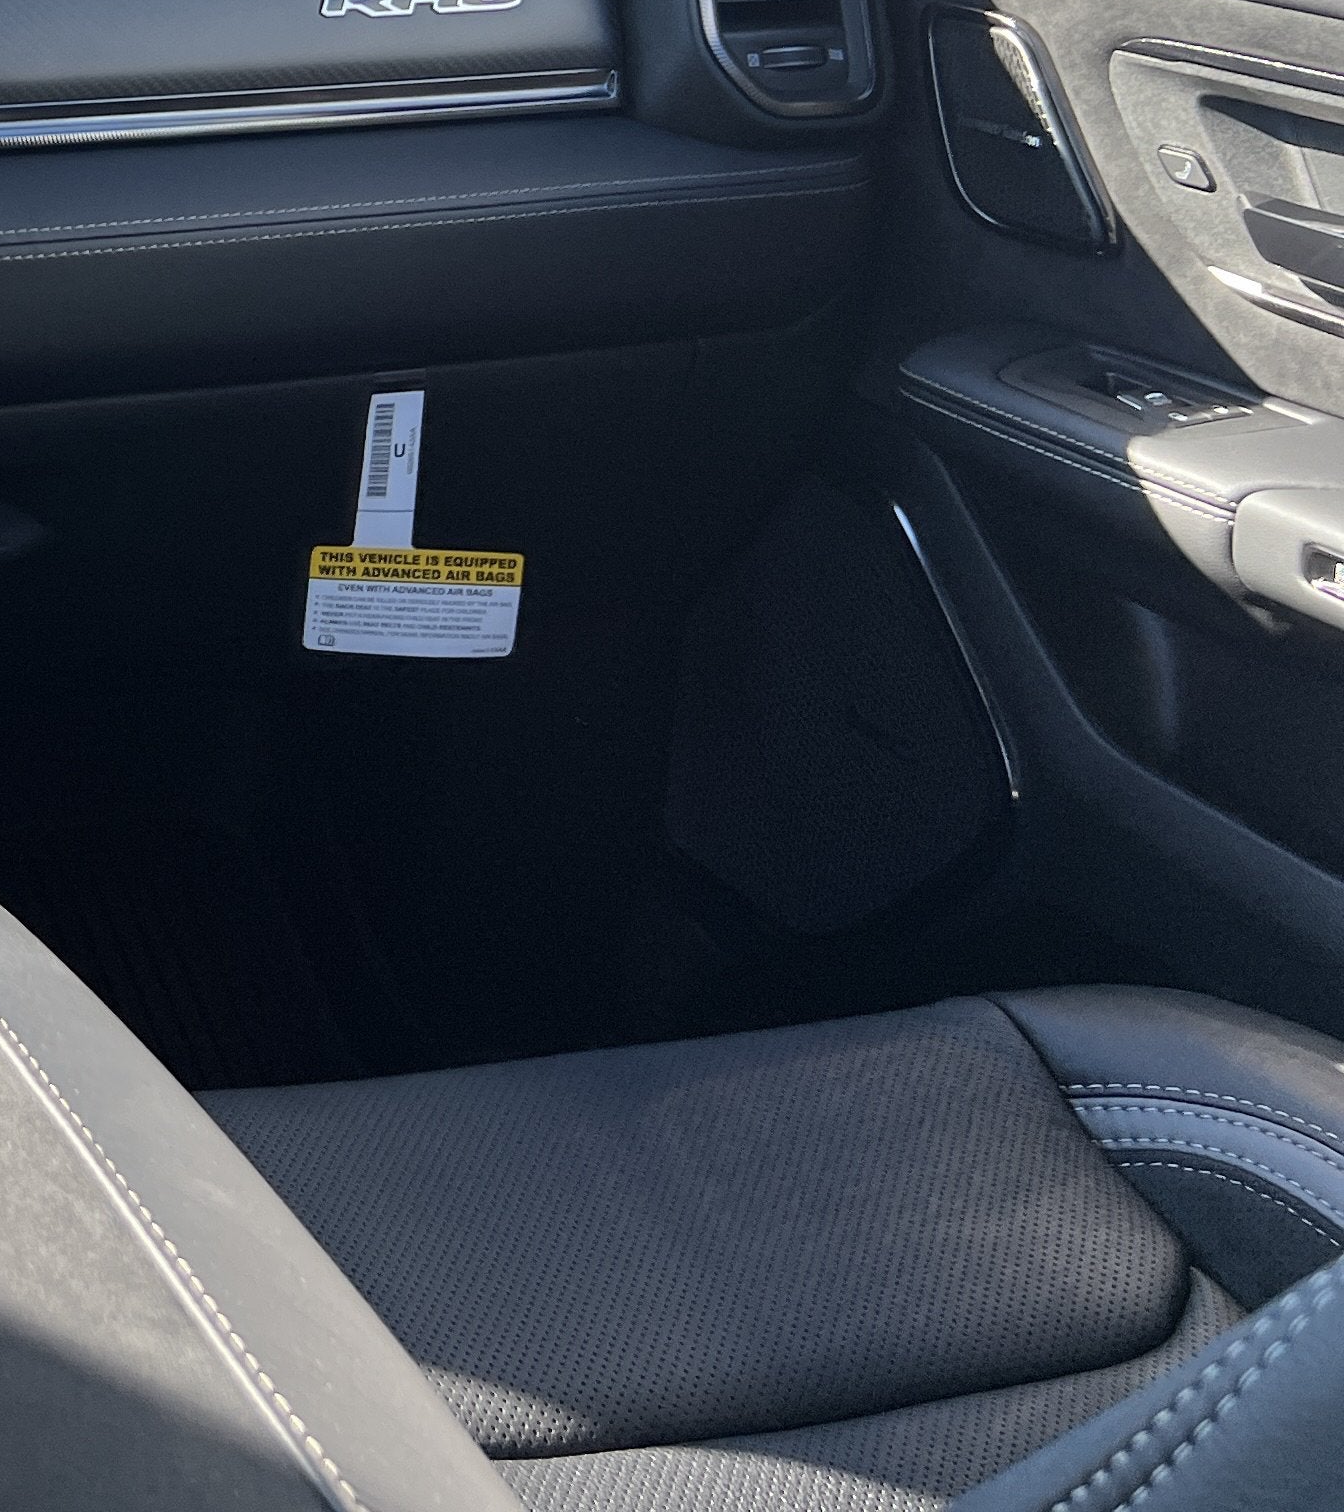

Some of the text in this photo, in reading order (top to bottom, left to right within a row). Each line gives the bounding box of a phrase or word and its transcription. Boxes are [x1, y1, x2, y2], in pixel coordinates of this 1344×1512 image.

[319, 551, 518, 569] THIS VEHICLE IS EQUIPPED
[318, 564, 515, 583] WITH ADVANCED AIR BAGS
[338, 584, 493, 597] EVEN WITH ADVANCED AIR BAGS
